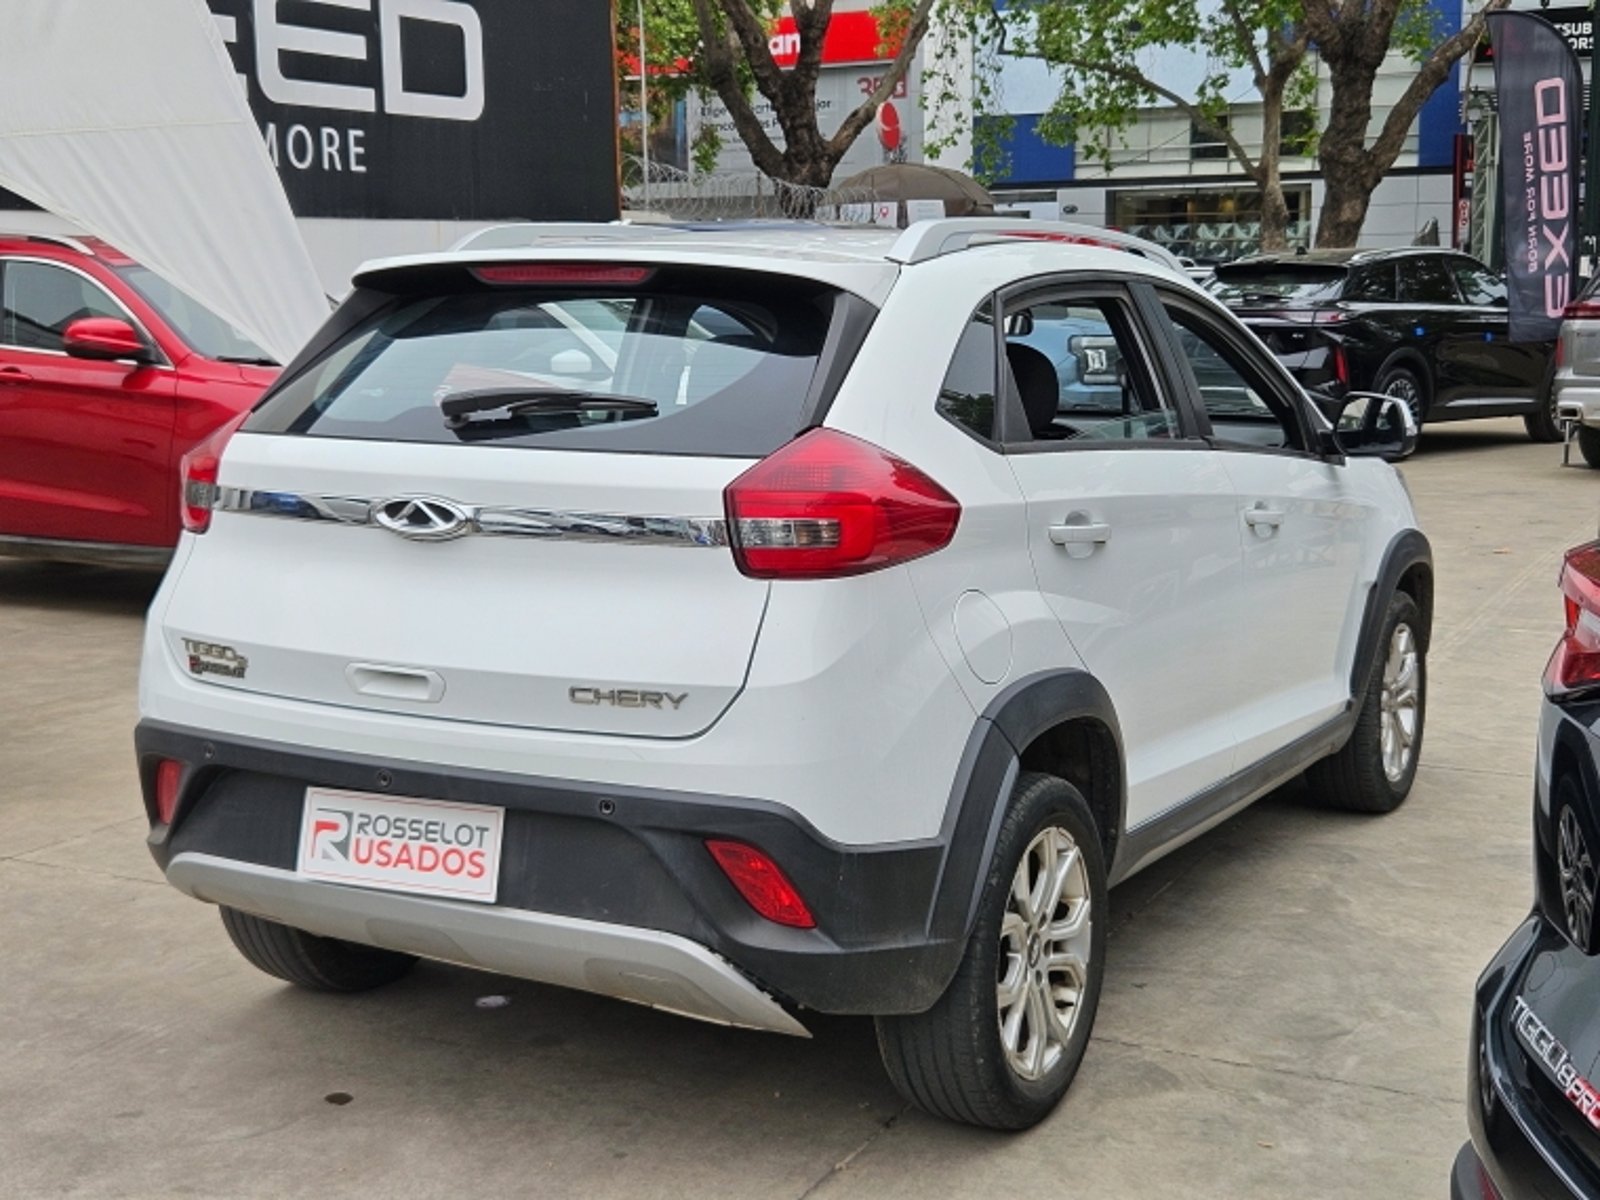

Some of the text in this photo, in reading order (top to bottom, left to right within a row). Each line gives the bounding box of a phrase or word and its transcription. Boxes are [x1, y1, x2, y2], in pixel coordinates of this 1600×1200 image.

[210, 0, 485, 121] ED
[569, 686, 689, 710] CHERY
[356, 813, 490, 848] ROSSELOT
[354, 838, 486, 879] USADOS
